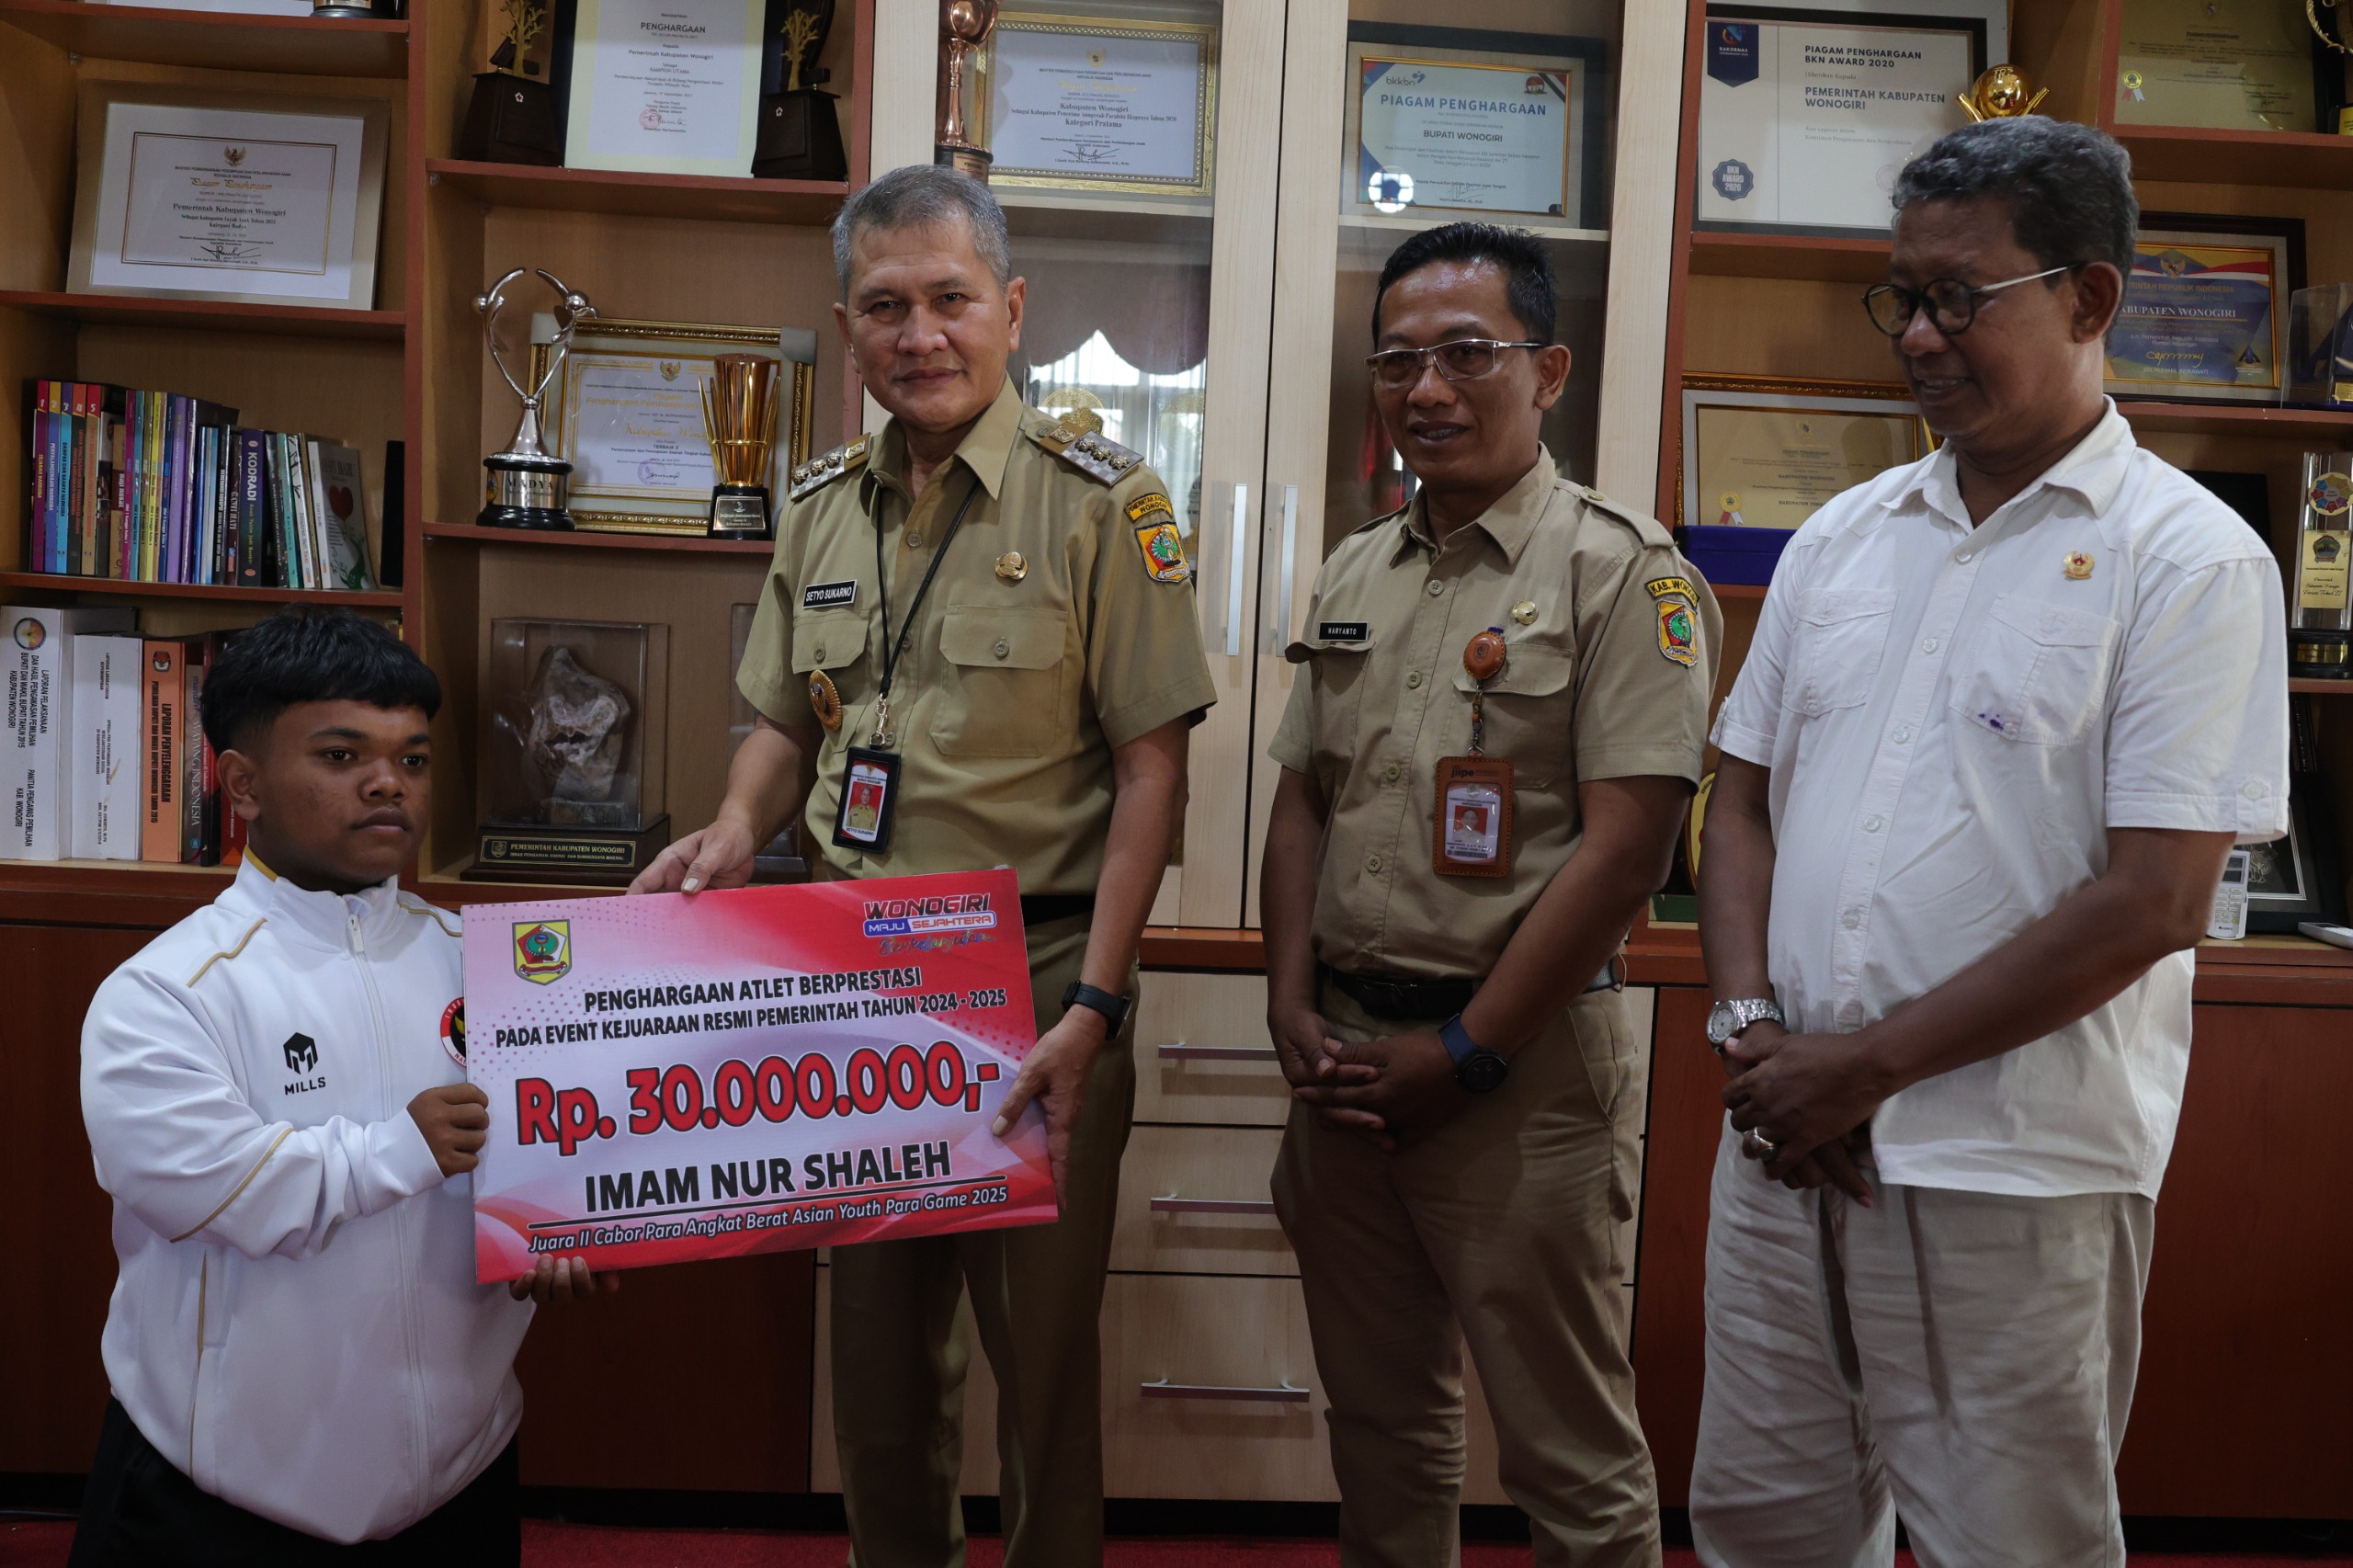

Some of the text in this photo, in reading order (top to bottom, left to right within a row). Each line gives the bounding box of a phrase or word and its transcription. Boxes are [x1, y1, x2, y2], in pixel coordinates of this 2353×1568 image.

[641, 22, 706, 33] PENGHARGAAN
[661, 51, 688, 60] Kabupaten
[1805, 45, 1921, 59] PIAGAM PENGHARGAAN
[1828, 57, 1865, 65] AWARD
[1869, 59, 1894, 67] 2020
[1385, 76, 1415, 86] bkkbn
[1805, 86, 1945, 103] PEMERINTAH KABUPATEN
[1060, 103, 1128, 113] Kabupaten Wonogiri
[1381, 95, 1546, 116] PIAGAM PENGHARGAAN
[1805, 98, 1866, 109] WONOGIRI
[1065, 119, 1122, 128] Kategori Pratama
[1423, 130, 1503, 142] BUPATI WONOGIRI
[1722, 174, 1744, 183] AWARD
[1727, 165, 1740, 175] BKN
[1725, 183, 1742, 191] 2020
[173, 203, 286, 216] Pemerintah Kabupaten Wonogiri
[2120, 305, 2236, 318] ABUPATEN WONOGIRI
[246, 451, 257, 501] KODRADI
[508, 478, 553, 490] MADYA
[229, 513, 237, 530] HATI
[806, 586, 852, 602] SETYO SUKARNO
[1650, 581, 1671, 595] KAB.
[1327, 627, 1357, 635] HARYANTO
[20, 652, 28, 670] BUPATI
[19, 681, 28, 699] WAKIL
[8, 670, 17, 728] KABUPATEN WONOGIRI
[28, 655, 40, 746] DAN HASIL PENGAWASAN PEMILIHAN
[40, 670, 50, 734] LAPORAN PELAKSANAAN
[18, 699, 27, 718] BUPATI
[18, 719, 27, 735] TAHUN
[17, 736, 26, 748] 2015
[161, 703, 172, 802] LAPORAN PENYELENGGARAAN
[190, 721, 200, 826] WAYANG INDONESIA
[15, 801, 23, 827] WONOGIRI
[24, 769, 35, 846] PANITIA PENGAWAS PEMILIHAN
[863, 893, 990, 920] WONOGIRI
[869, 915, 992, 933] MAJU SEJAHTERA
[585, 967, 922, 1012] PENGHARGAAN ATLET BERPRESTASI
[496, 1026, 541, 1048] PADA
[546, 1021, 598, 1044] EVENT
[602, 1013, 700, 1040] KEJUARAAN
[704, 1009, 753, 1031] RESMI
[756, 1000, 859, 1028] PEMERINTAH
[862, 995, 916, 1019] TAHUN
[284, 1076, 326, 1096] MILLS
[516, 1040, 1000, 1156] Rp. 30.000.000,-
[585, 1141, 951, 1213] IMAM NUR SHALEH
[529, 1187, 1007, 1252] Juara II Cabor Para Angkat Berat Asian Youth Para Game 2025
